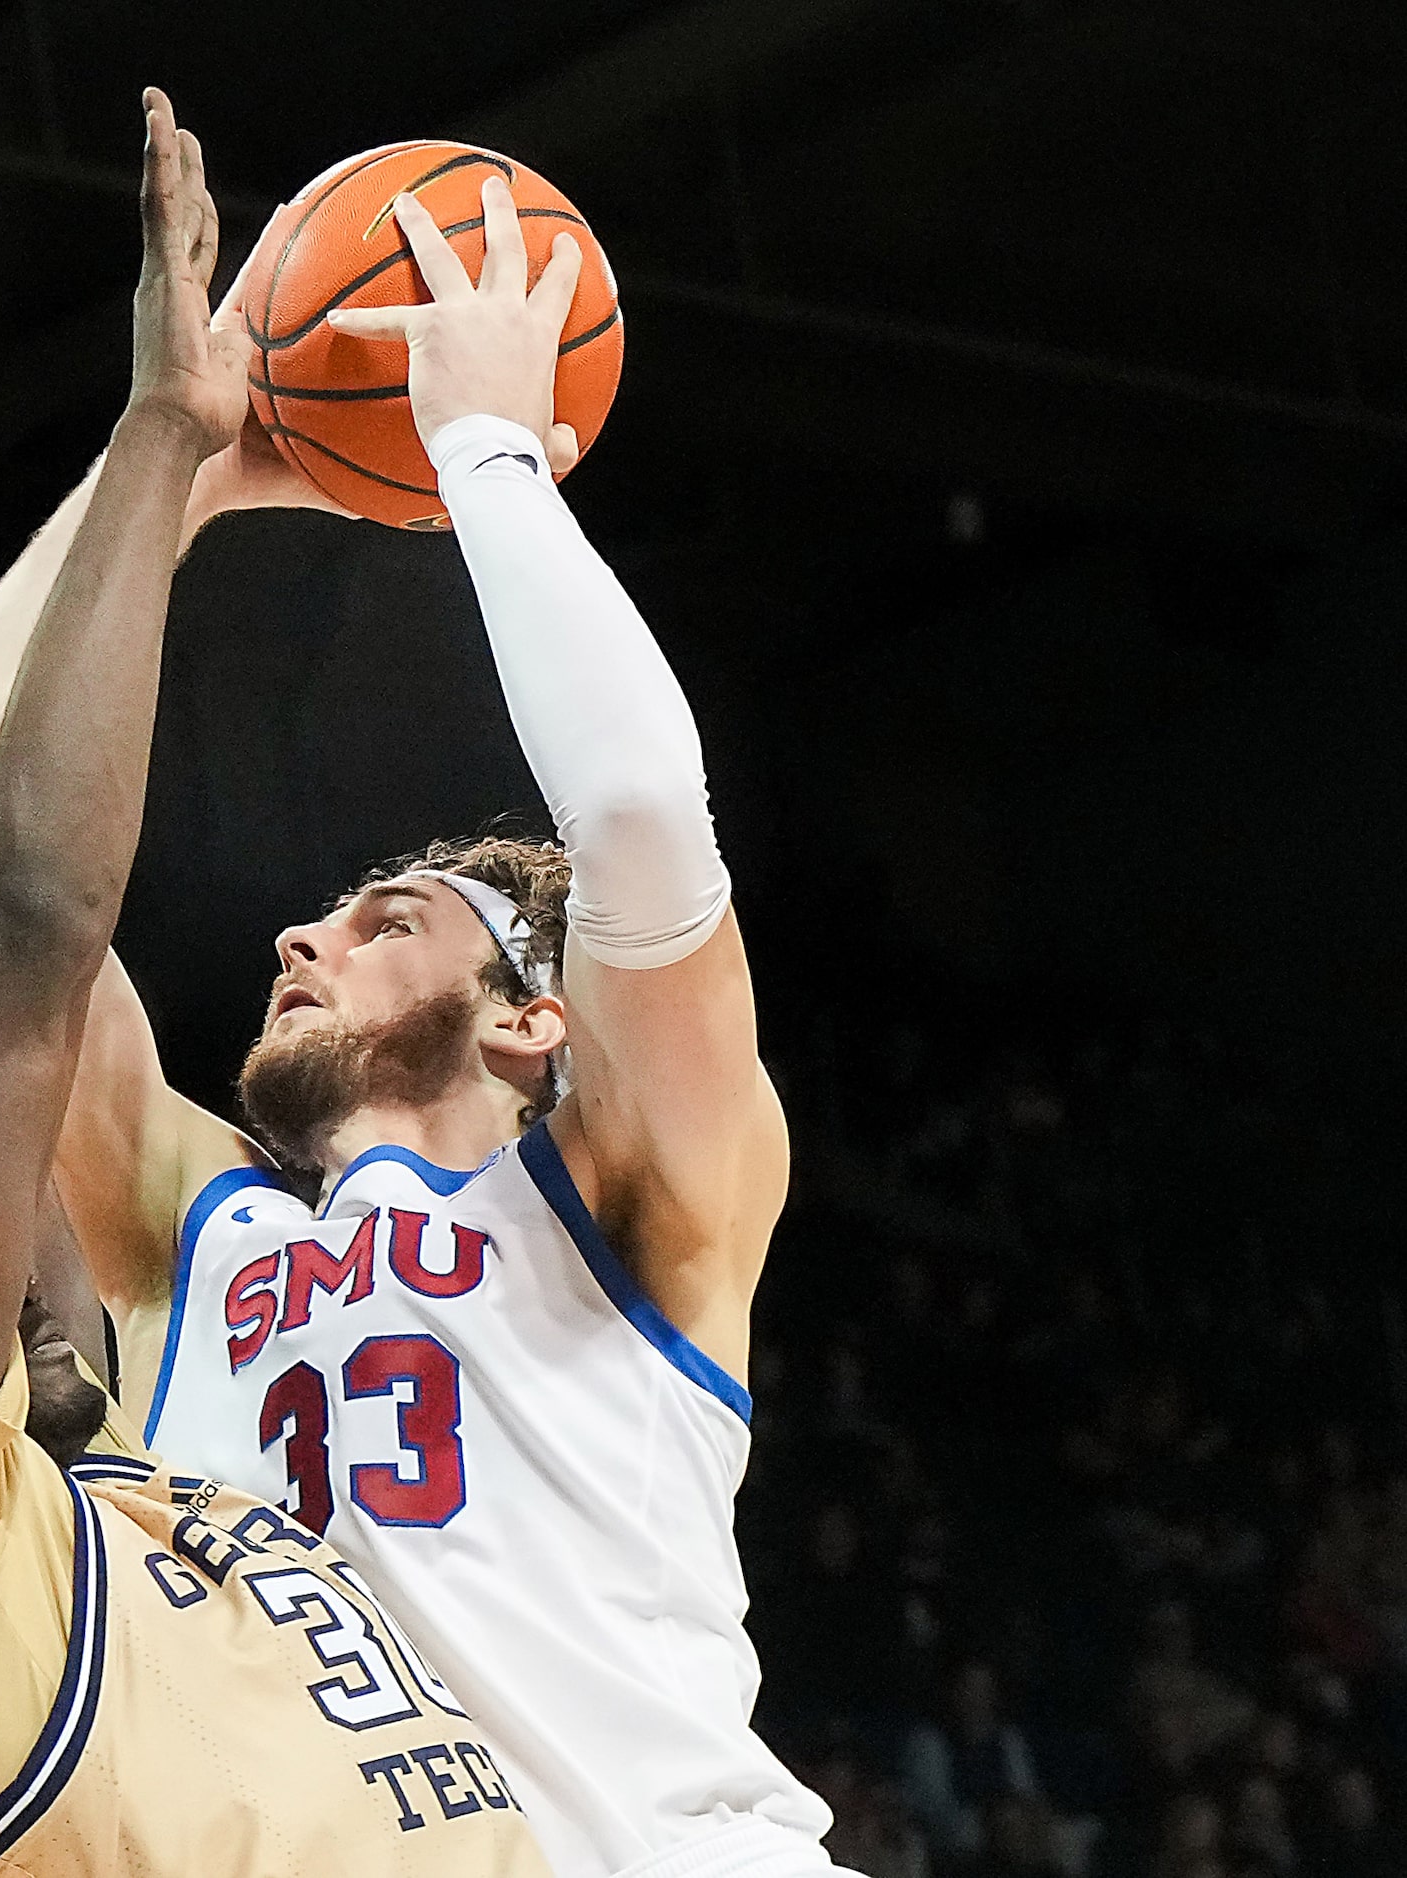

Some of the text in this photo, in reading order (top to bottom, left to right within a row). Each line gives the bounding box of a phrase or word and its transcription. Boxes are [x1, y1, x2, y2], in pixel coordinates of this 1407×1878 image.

[225, 1206, 490, 1375] SMU
[259, 1333, 467, 1538] 33
[357, 1741, 528, 1832] TEC
